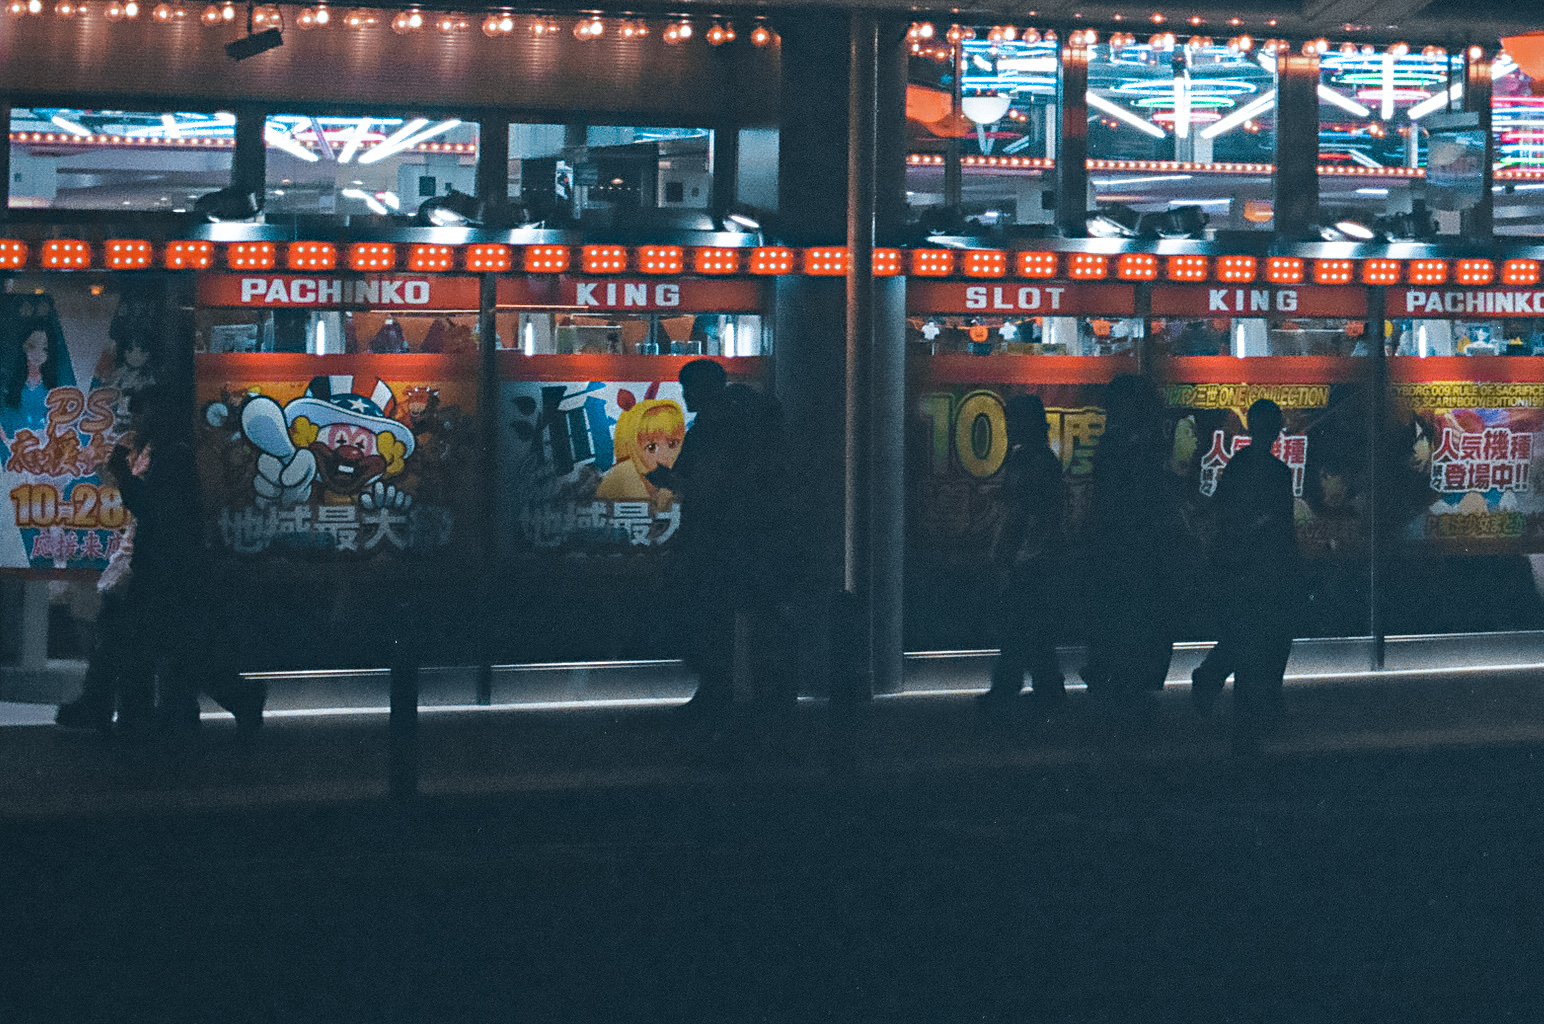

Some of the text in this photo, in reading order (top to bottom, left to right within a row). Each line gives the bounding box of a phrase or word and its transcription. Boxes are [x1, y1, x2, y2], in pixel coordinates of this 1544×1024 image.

[240, 278, 431, 304] PACHINKO
[576, 282, 681, 307] KING
[965, 286, 1065, 309] SLOT
[1208, 289, 1298, 312] KING
[1432, 428, 1533, 463] 人気機種
